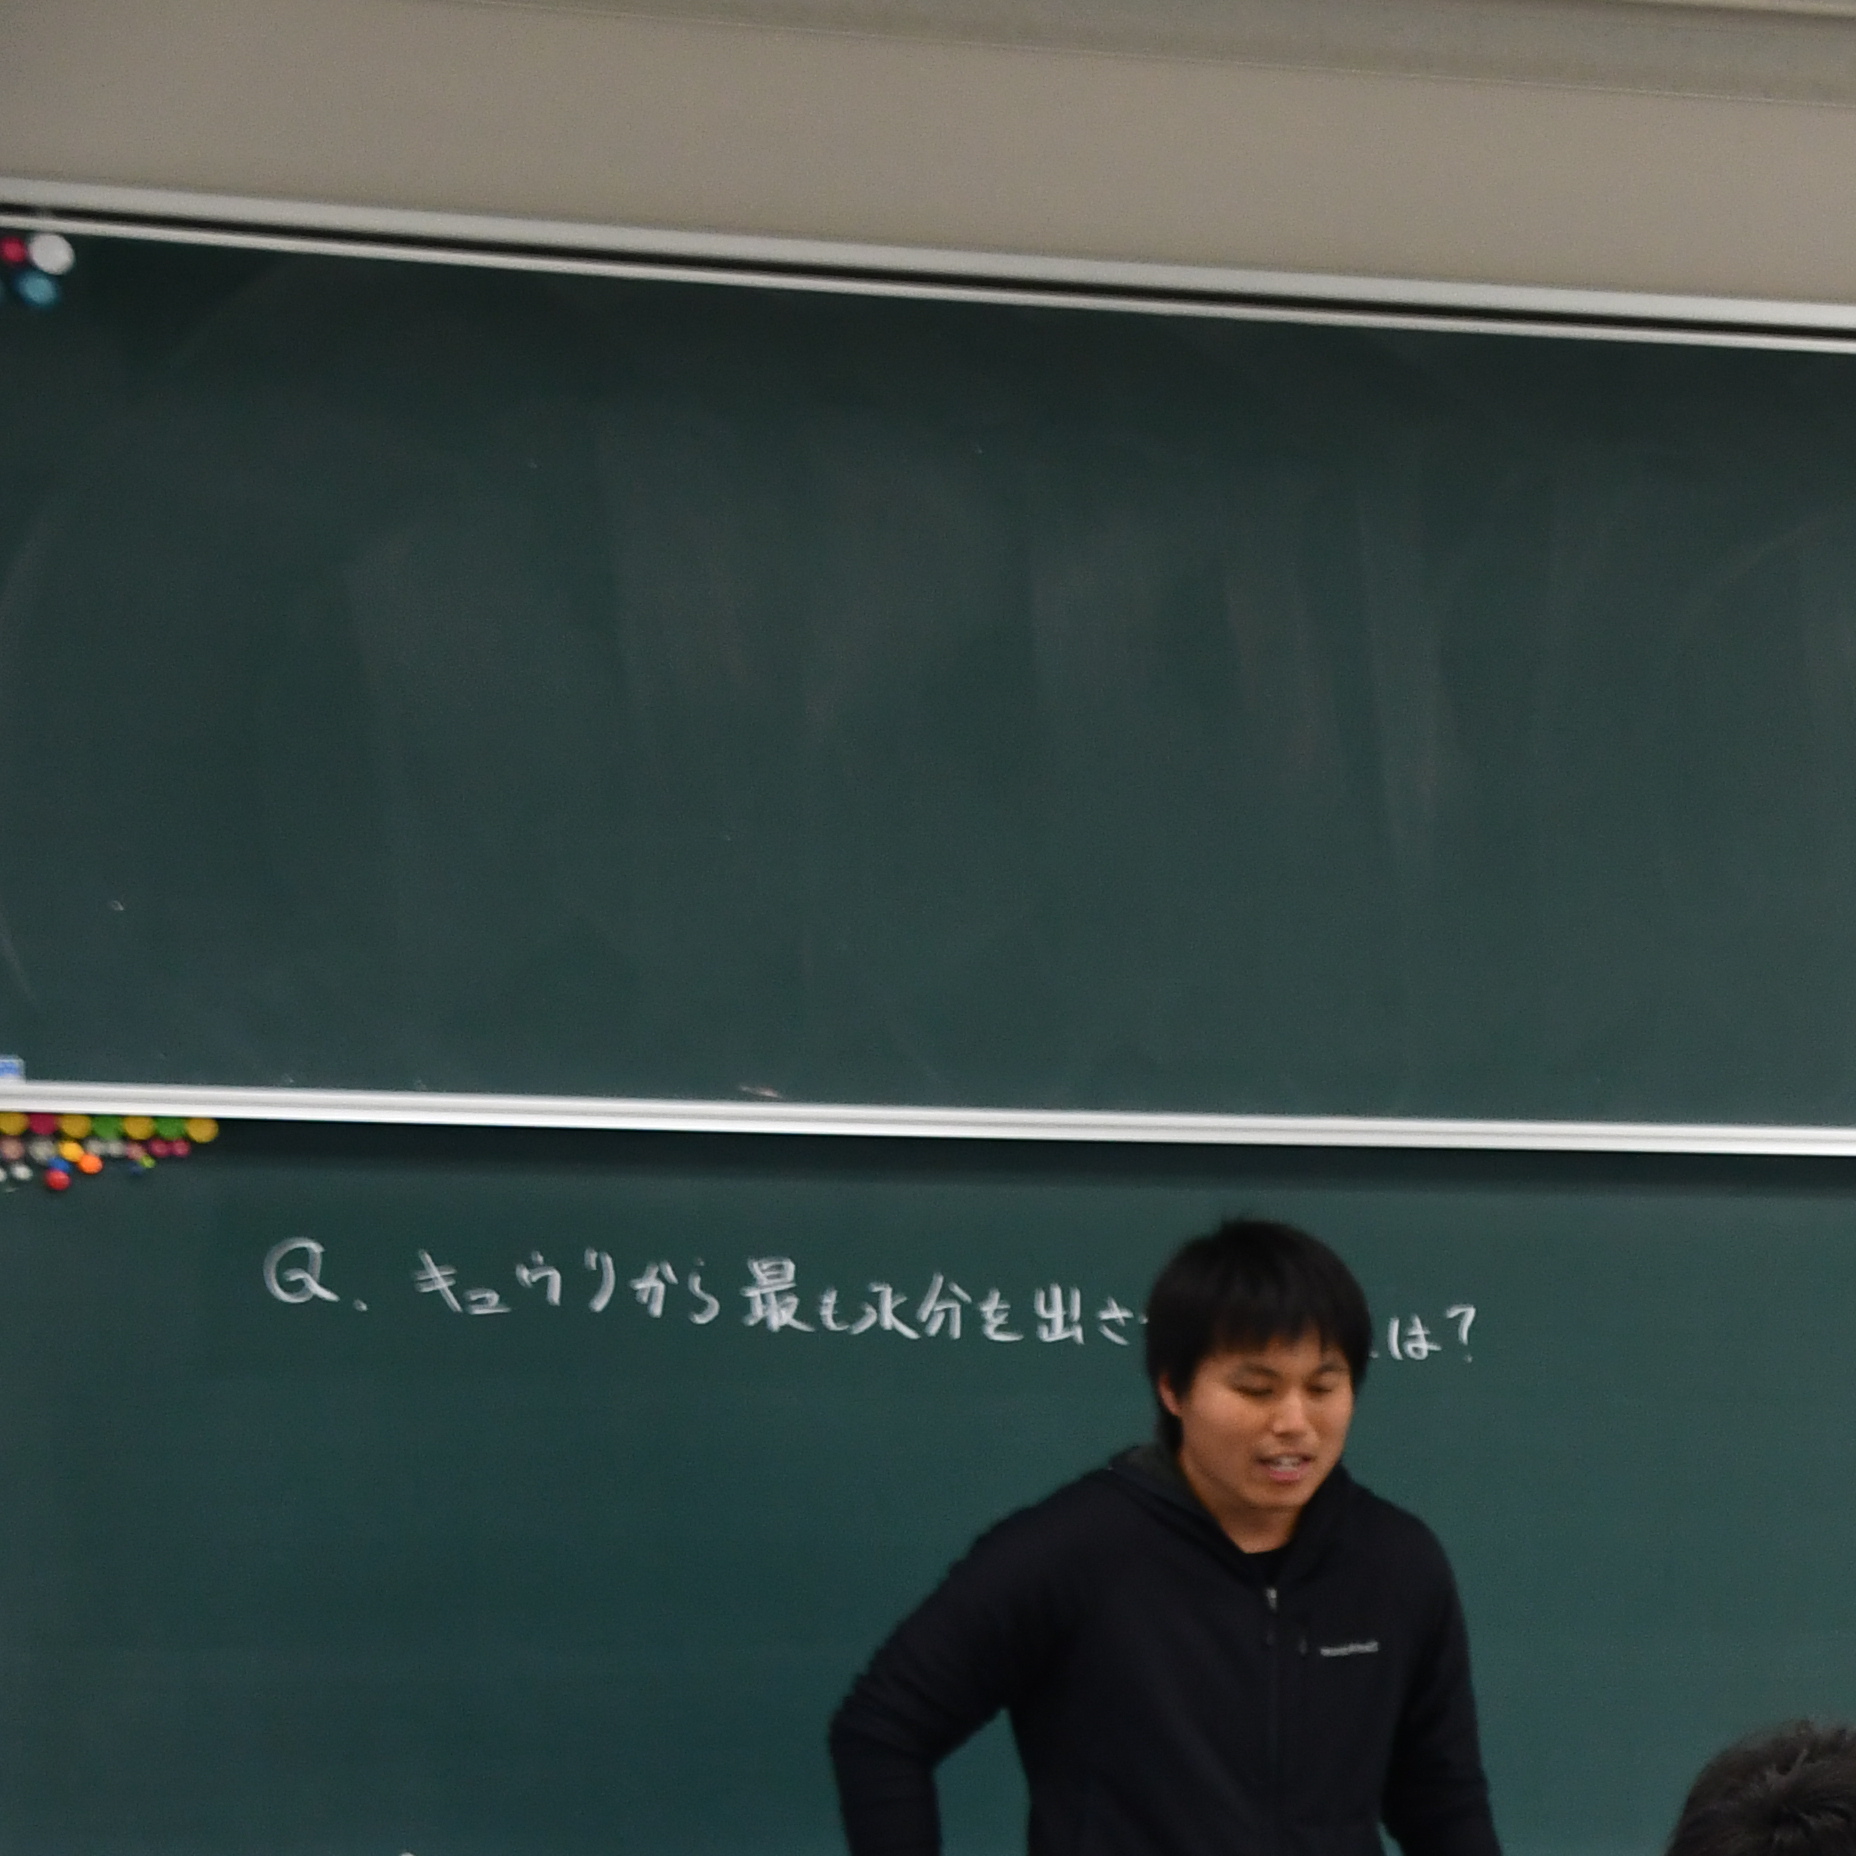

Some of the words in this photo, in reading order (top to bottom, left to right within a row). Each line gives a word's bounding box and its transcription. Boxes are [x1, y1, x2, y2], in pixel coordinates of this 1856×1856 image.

[411, 1246, 1149, 1346] キュウリから最も水分を出さ
